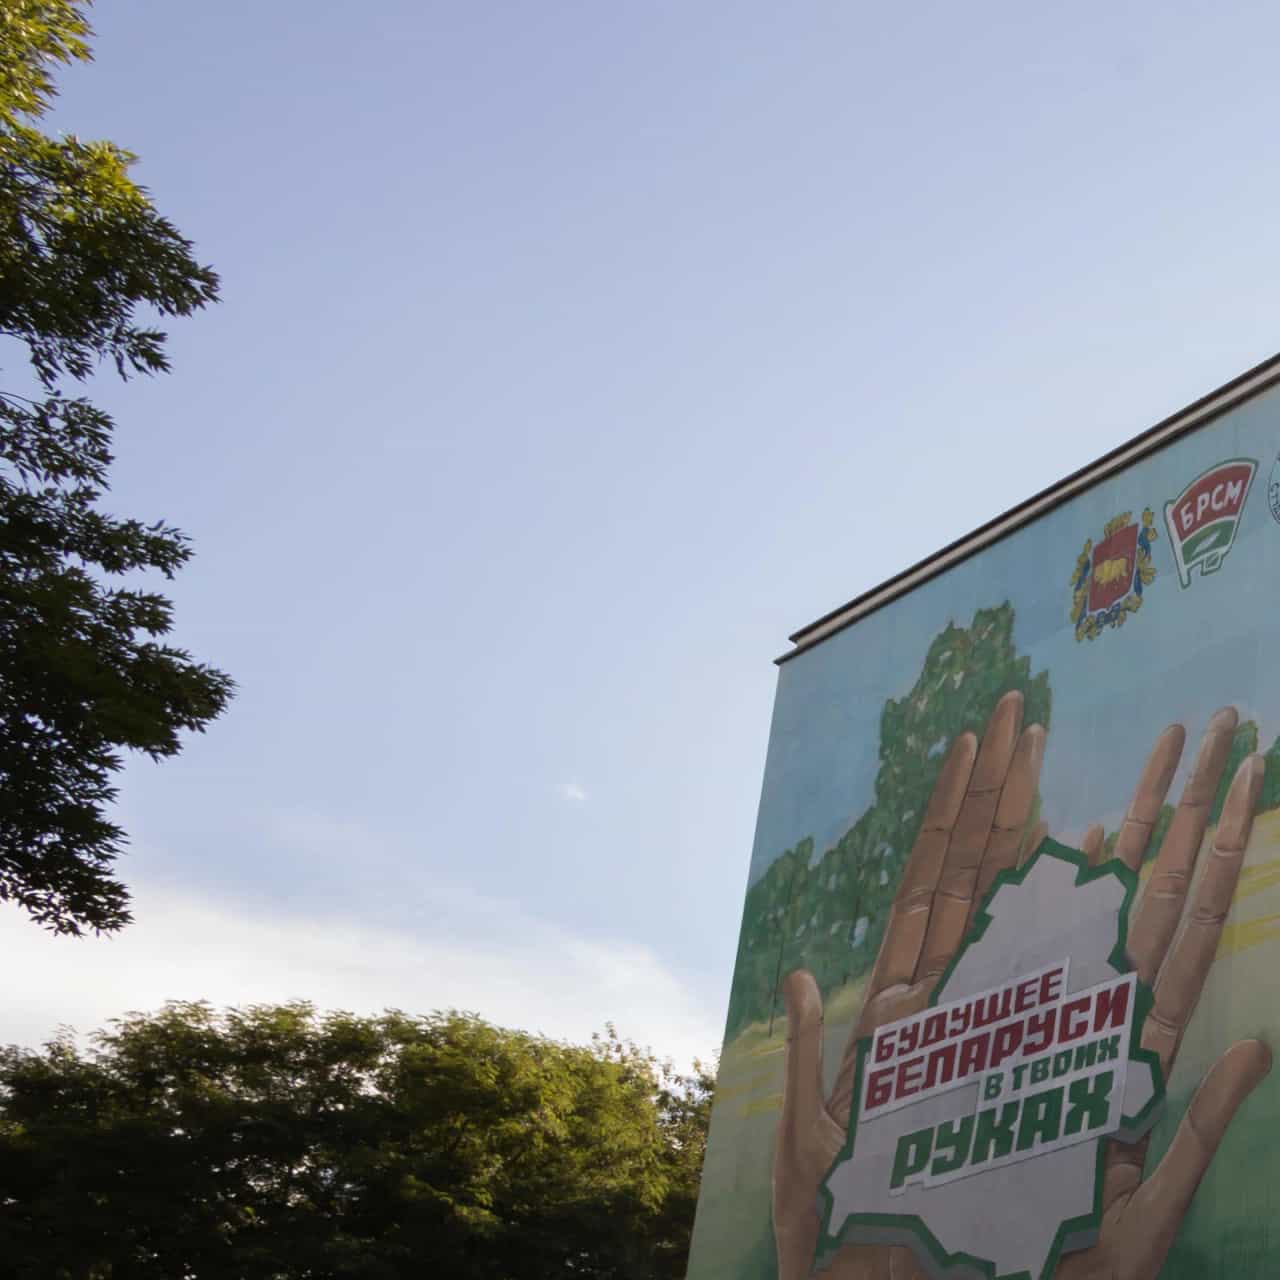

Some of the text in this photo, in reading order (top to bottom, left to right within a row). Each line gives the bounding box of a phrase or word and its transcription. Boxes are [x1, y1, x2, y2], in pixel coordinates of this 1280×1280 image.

[1180, 478, 1243, 530] БРСМ
[865, 981, 1132, 1111] БЕЛАРУСИ
[874, 967, 1064, 1064] БУДУЩЕЕ
[889, 1070, 1115, 1190] РУКАХ
